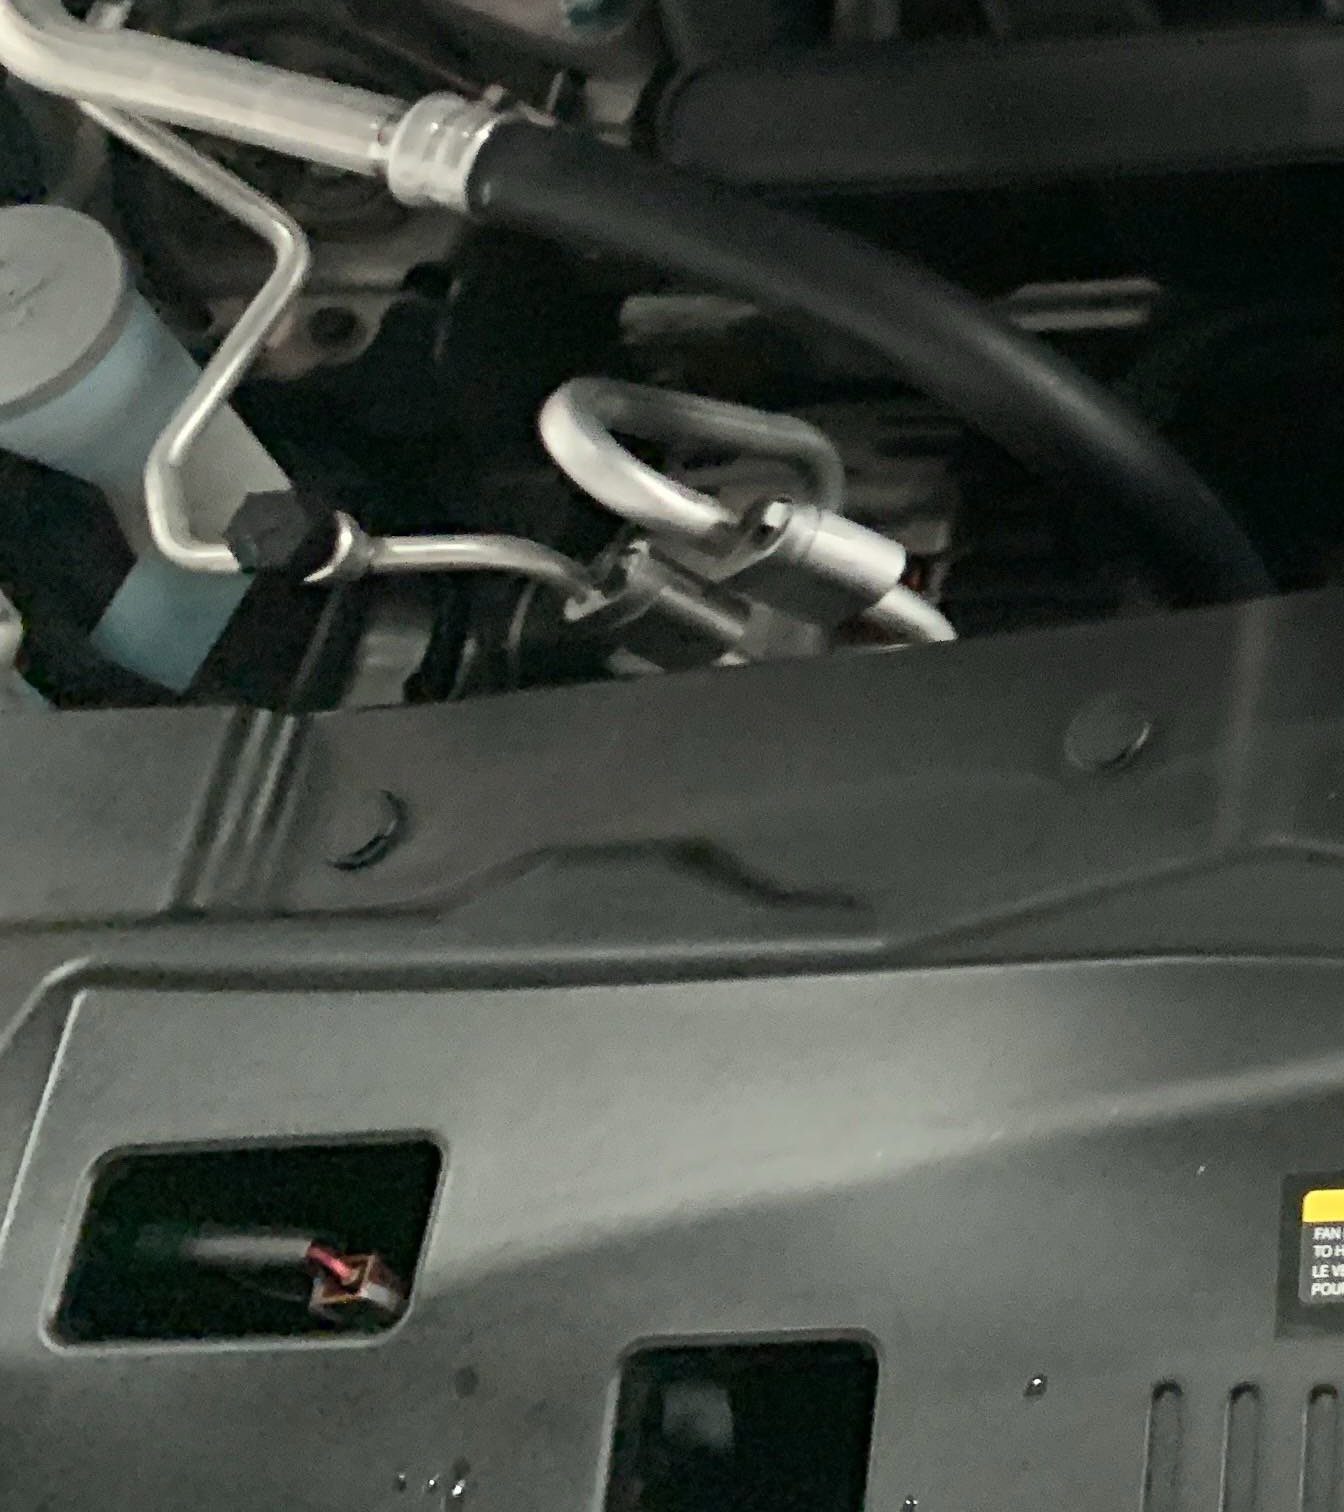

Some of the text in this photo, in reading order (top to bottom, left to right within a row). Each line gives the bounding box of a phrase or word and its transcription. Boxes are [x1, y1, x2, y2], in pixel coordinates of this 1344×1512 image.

[1314, 1227, 1341, 1240] FAN
[1314, 1245, 1333, 1257] TO
[1312, 1265, 1329, 1278] LE
